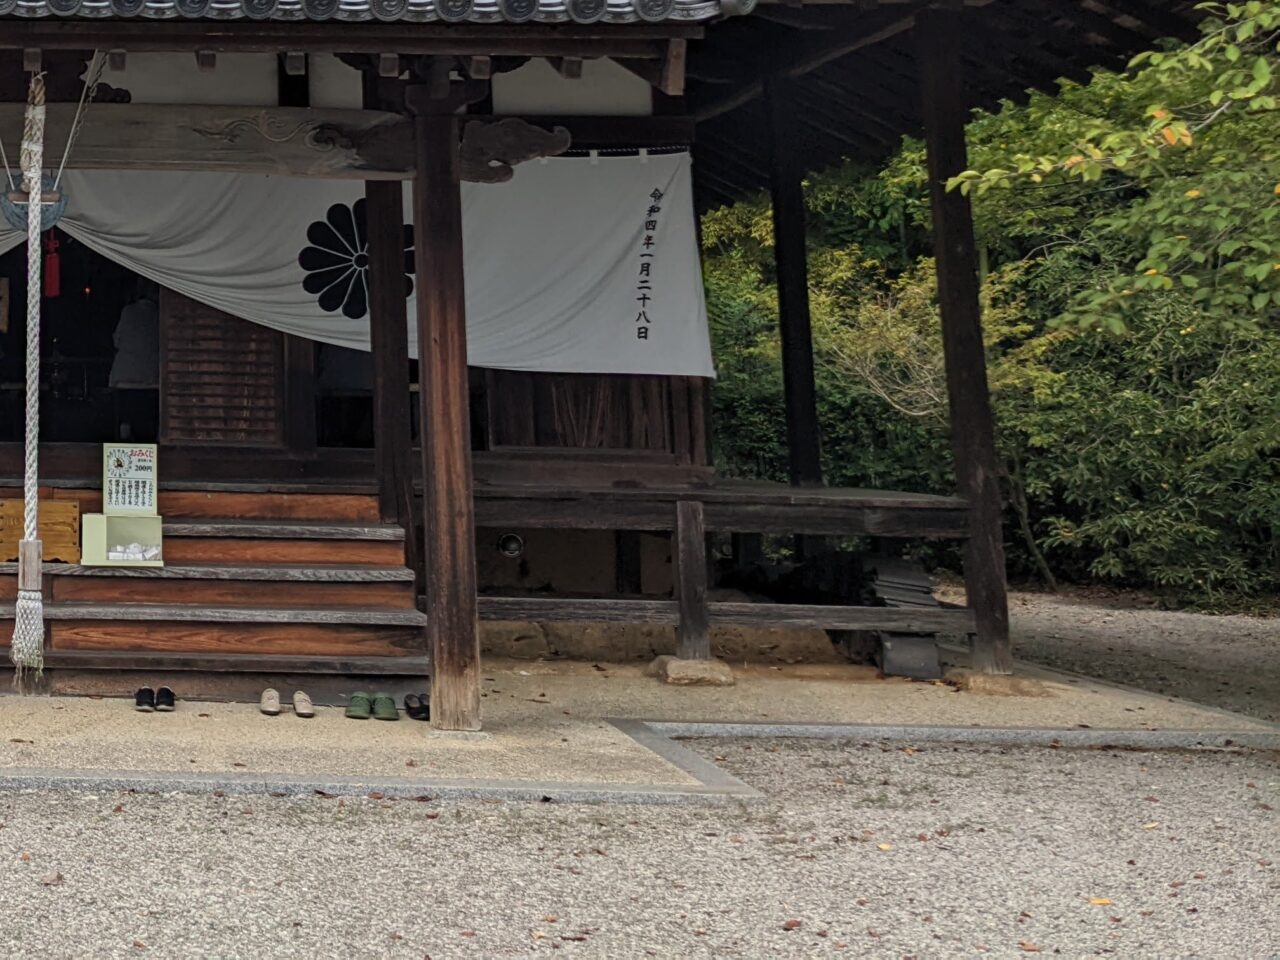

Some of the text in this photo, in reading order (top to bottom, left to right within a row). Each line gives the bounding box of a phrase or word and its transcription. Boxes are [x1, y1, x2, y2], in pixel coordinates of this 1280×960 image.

[636, 188, 663, 340] 令和四年一月二十八日
